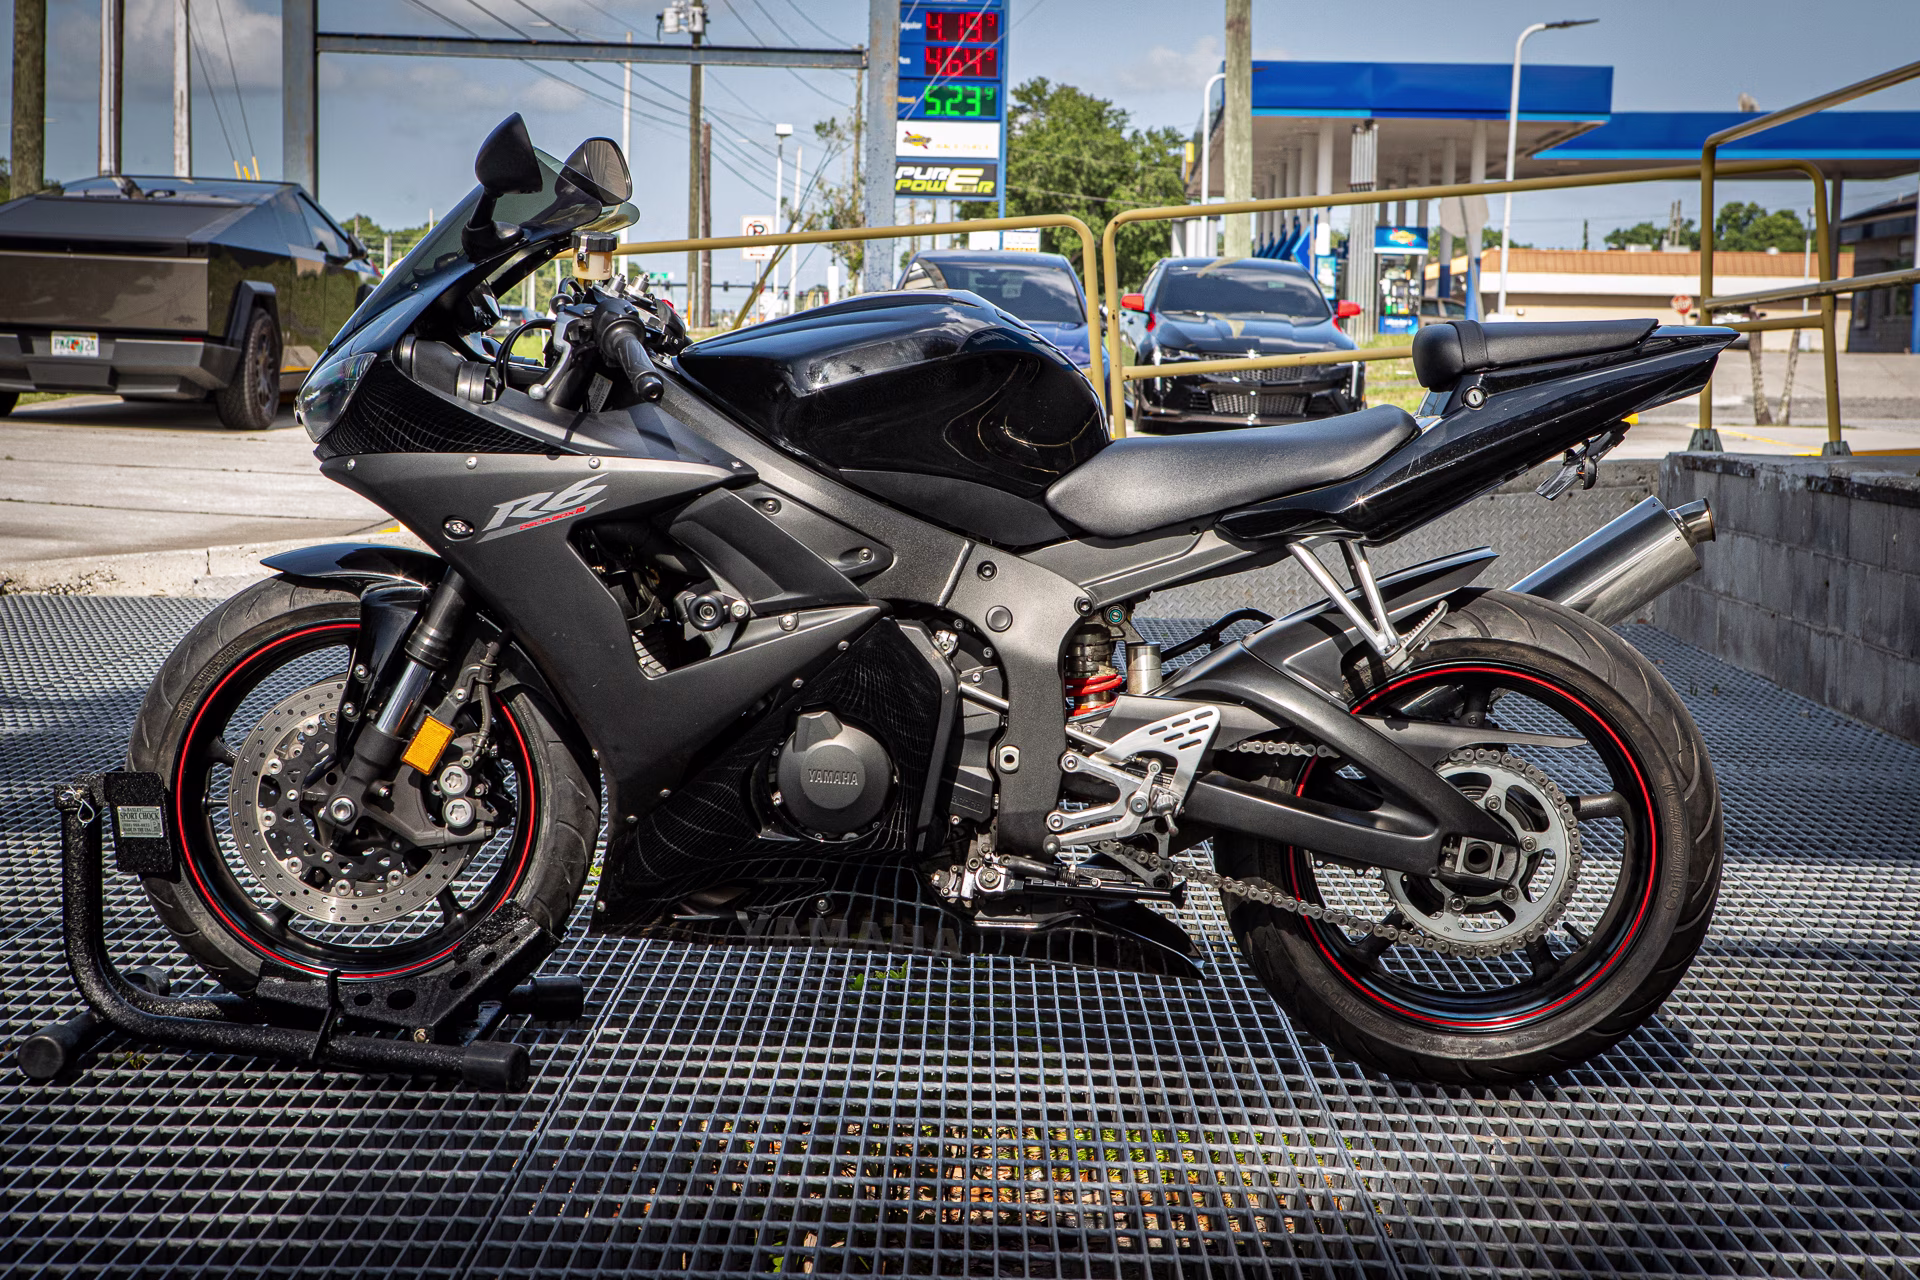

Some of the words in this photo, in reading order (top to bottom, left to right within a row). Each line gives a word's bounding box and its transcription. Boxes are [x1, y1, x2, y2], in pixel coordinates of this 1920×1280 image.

[482, 473, 608, 532] R6
[808, 769, 858, 785] YAMAHA
[120, 812, 138, 820] SPORT
[139, 812, 160, 820] CHOCK
[736, 910, 962, 960] YAMAHA
